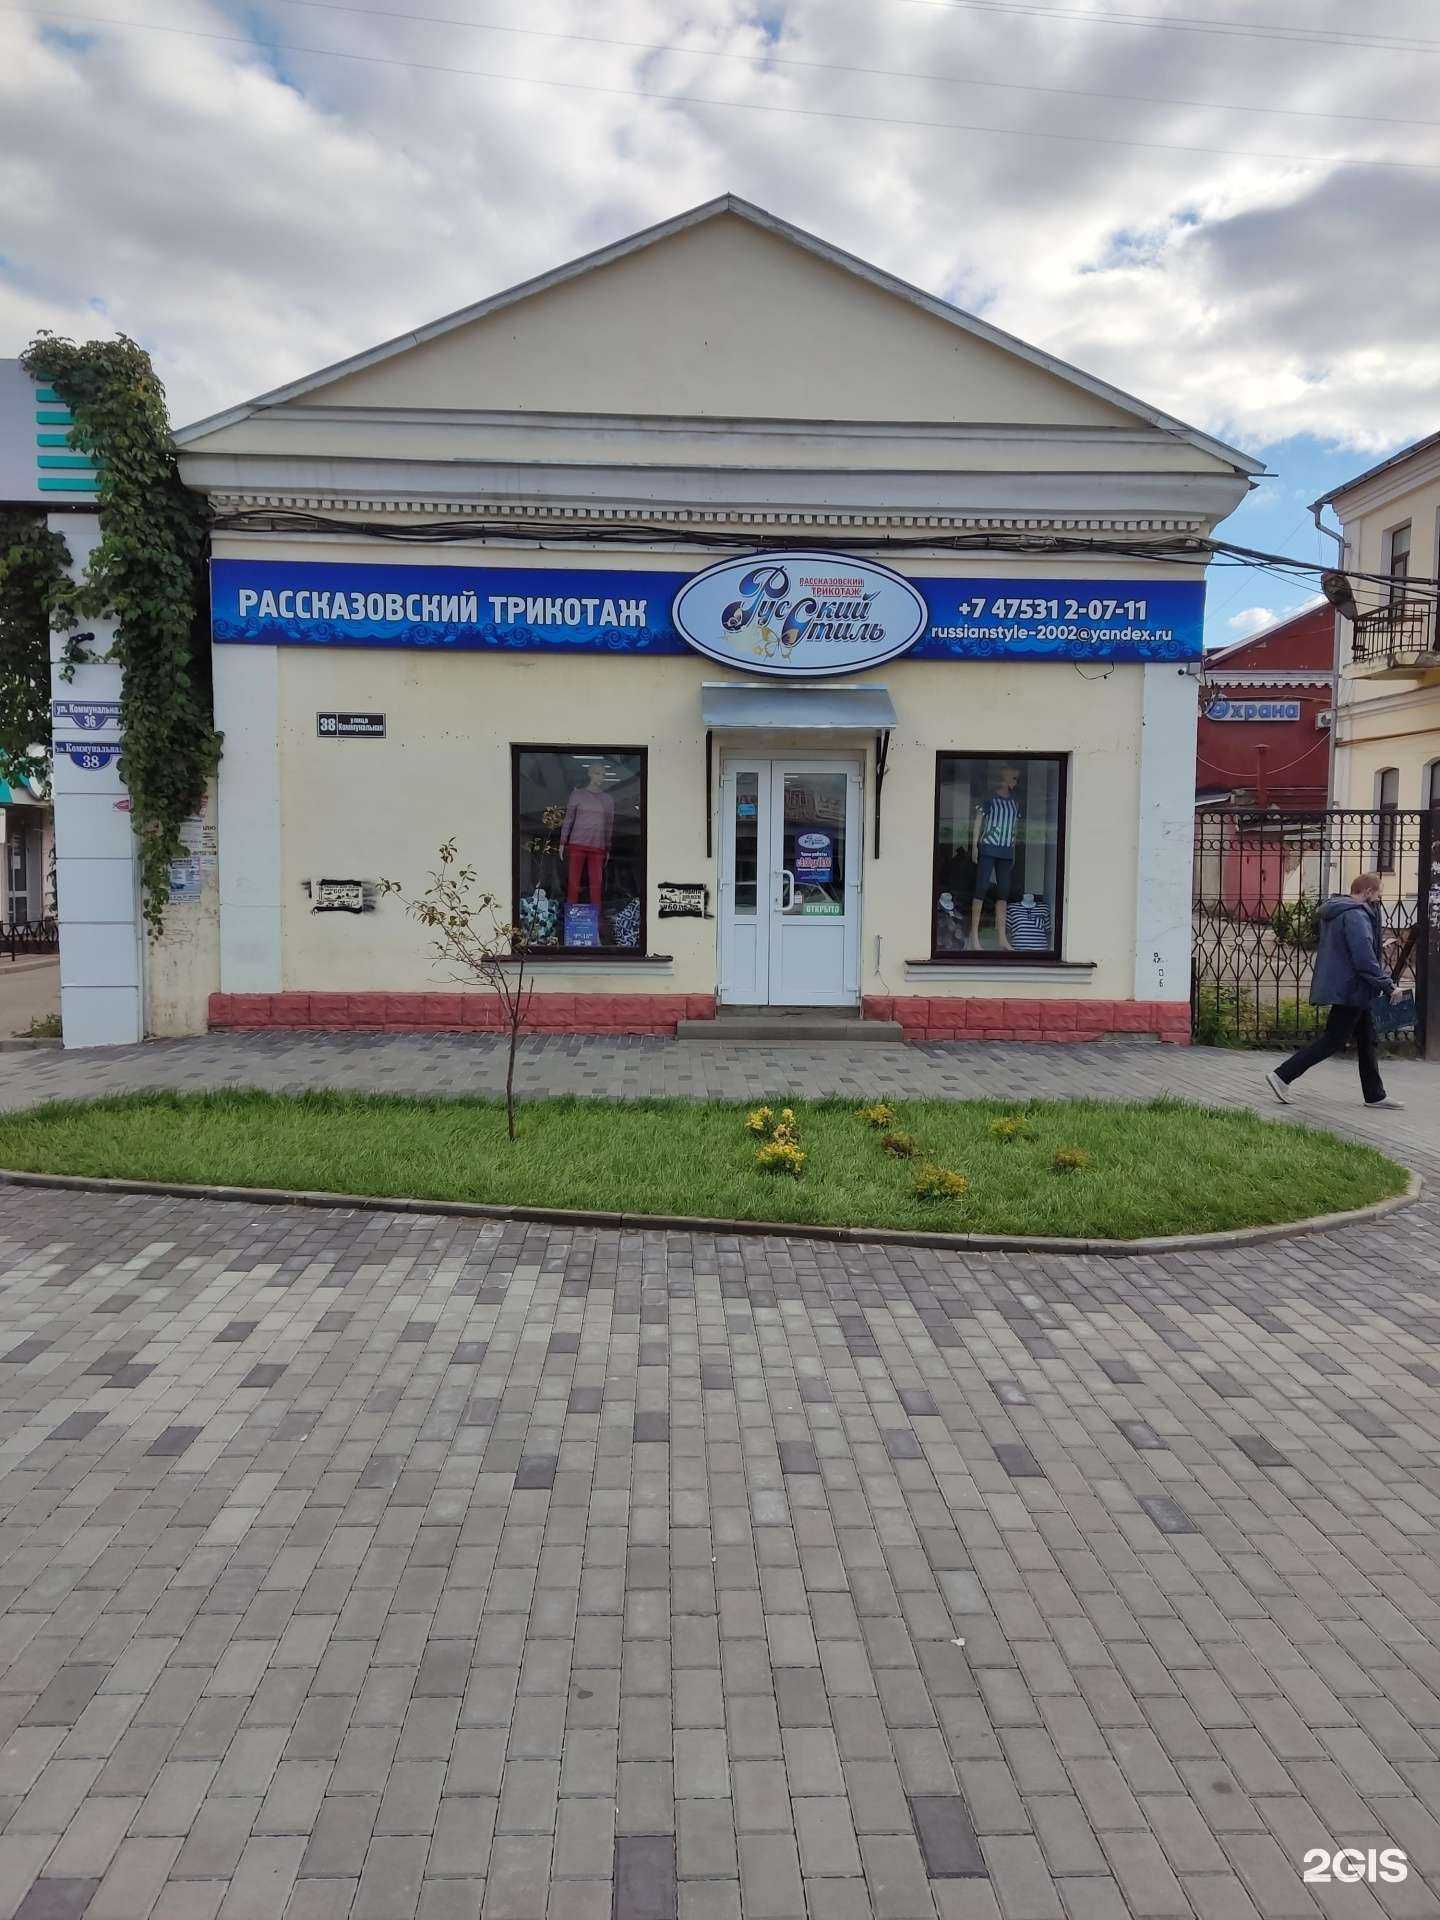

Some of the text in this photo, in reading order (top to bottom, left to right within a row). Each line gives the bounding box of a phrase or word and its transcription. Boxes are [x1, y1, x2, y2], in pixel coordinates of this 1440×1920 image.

[799, 577, 865, 587] РАССКАЗОВСКИЙ
[811, 587, 862, 597] ТРИКОТАЖ
[238, 588, 648, 627] РАССКАЗОВСКИЙ ТРИКОТАЖ
[958, 598, 1147, 621] +7 47531 2-07-11
[931, 624, 1172, 643] russianstyle-2002@yandex.ru
[69, 703, 122, 715] Коммунальна
[84, 715, 96, 727] 36
[319, 718, 336, 731] 38
[82, 755, 100, 768] 38
[806, 905, 840, 914] ОТКРЫТО
